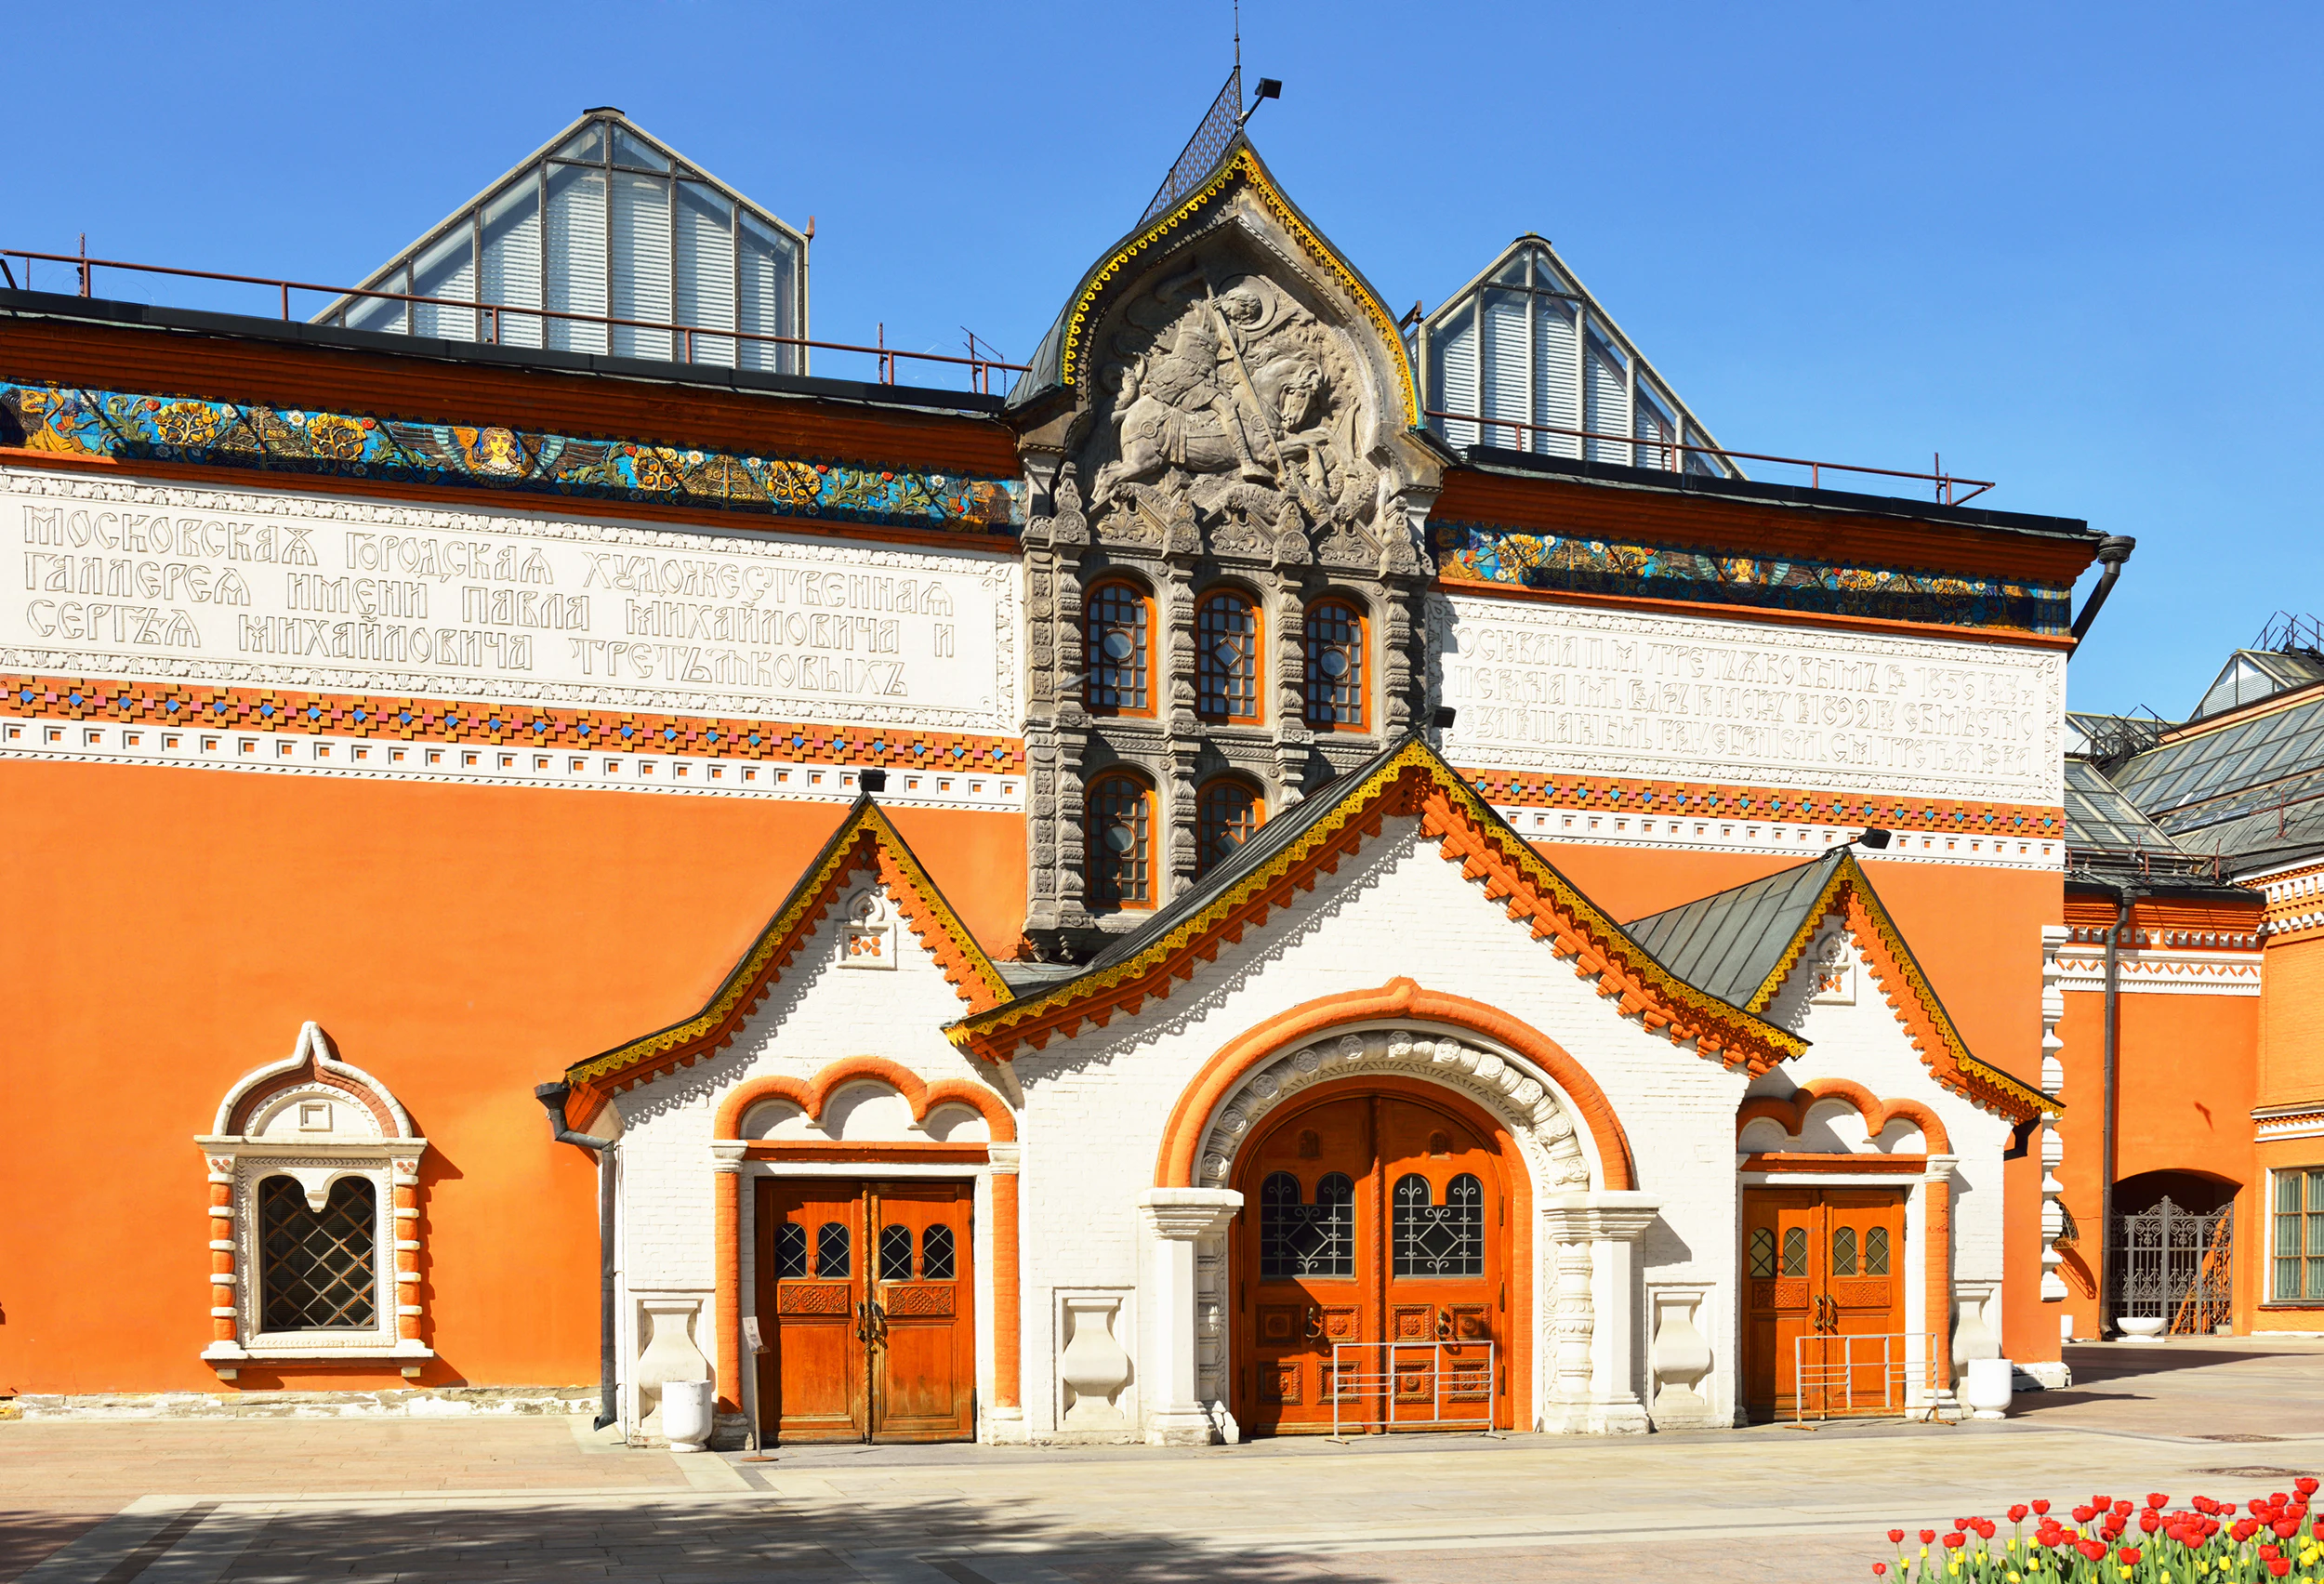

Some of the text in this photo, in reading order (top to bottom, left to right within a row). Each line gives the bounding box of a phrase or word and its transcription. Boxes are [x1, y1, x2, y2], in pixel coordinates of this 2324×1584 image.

[238, 614, 533, 671] МИХАЙЛОВИЧА
[287, 572, 429, 619] ИМЕНИ
[462, 586, 590, 631] ПАВЛА
[626, 598, 900, 654] МИХАЙЛОВИЧА
[933, 623, 955, 658] И
[1914, 667, 1976, 702] 1856
